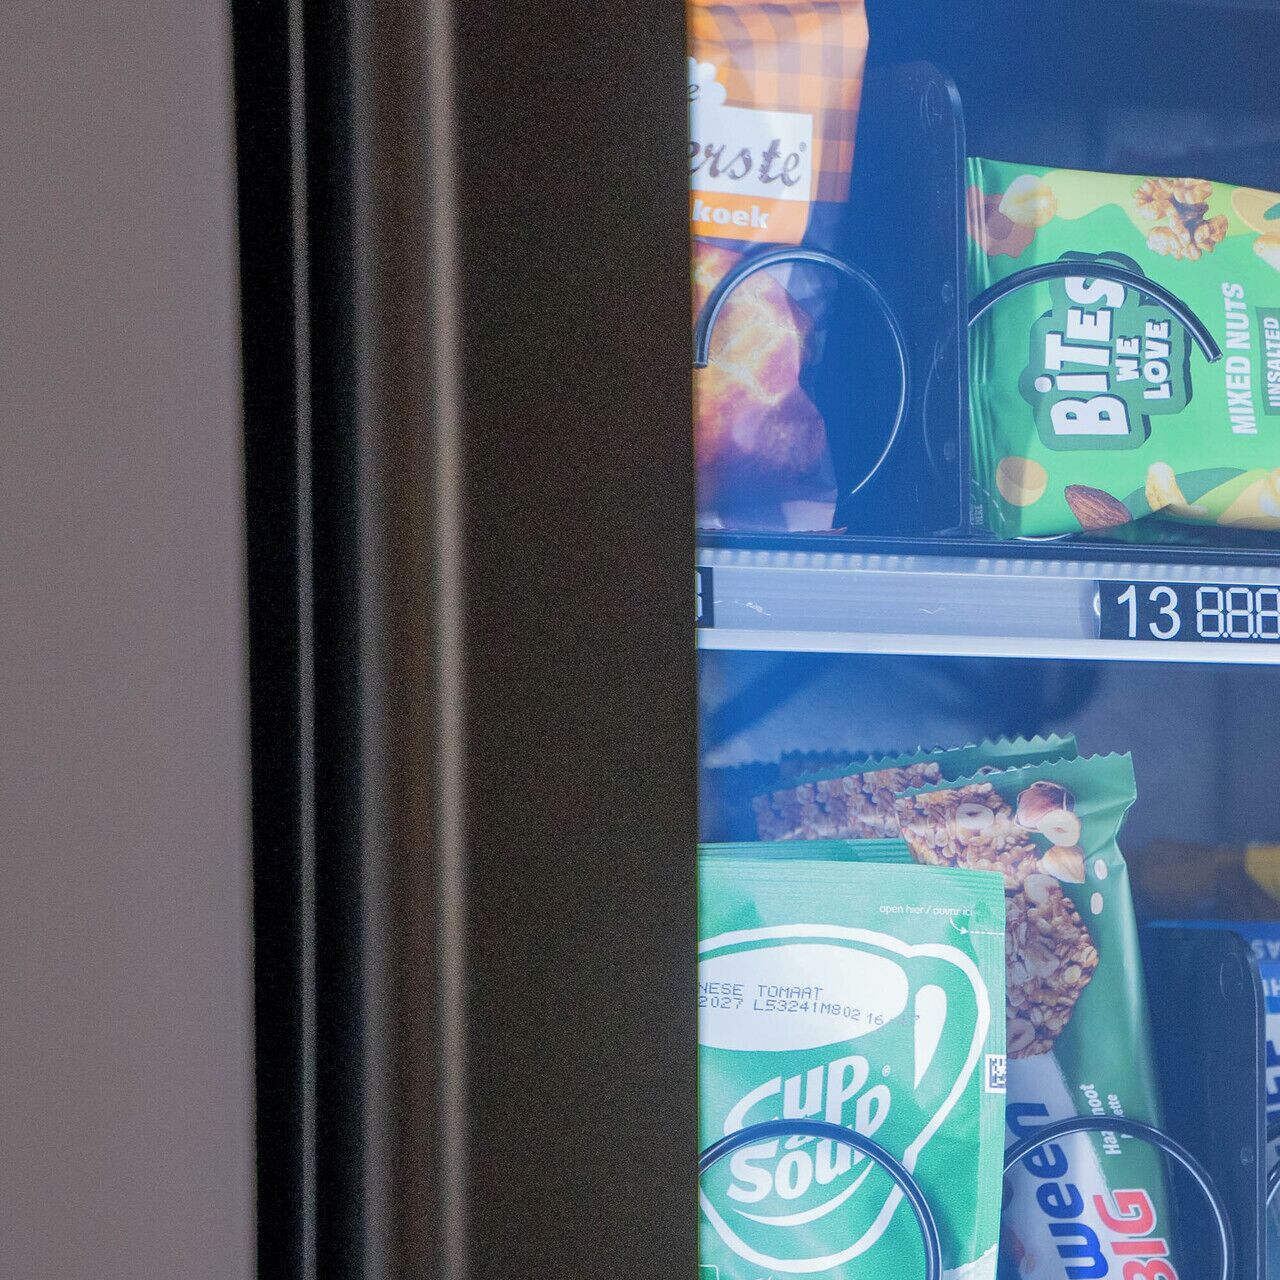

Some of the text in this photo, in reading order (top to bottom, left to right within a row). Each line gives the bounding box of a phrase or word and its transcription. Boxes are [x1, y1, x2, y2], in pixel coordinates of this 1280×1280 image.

[692, 200, 769, 229] koek
[1115, 335, 1141, 382] WE
[1143, 319, 1173, 400] LOVE
[1221, 282, 1257, 434] MIXED NUTS
[1117, 584, 1181, 640] 13
[880, 905, 903, 914] open
[699, 996, 743, 1010] 2027
[758, 984, 824, 1000] TOMAAT
[1080, 1084, 1123, 1156] Haznoot
